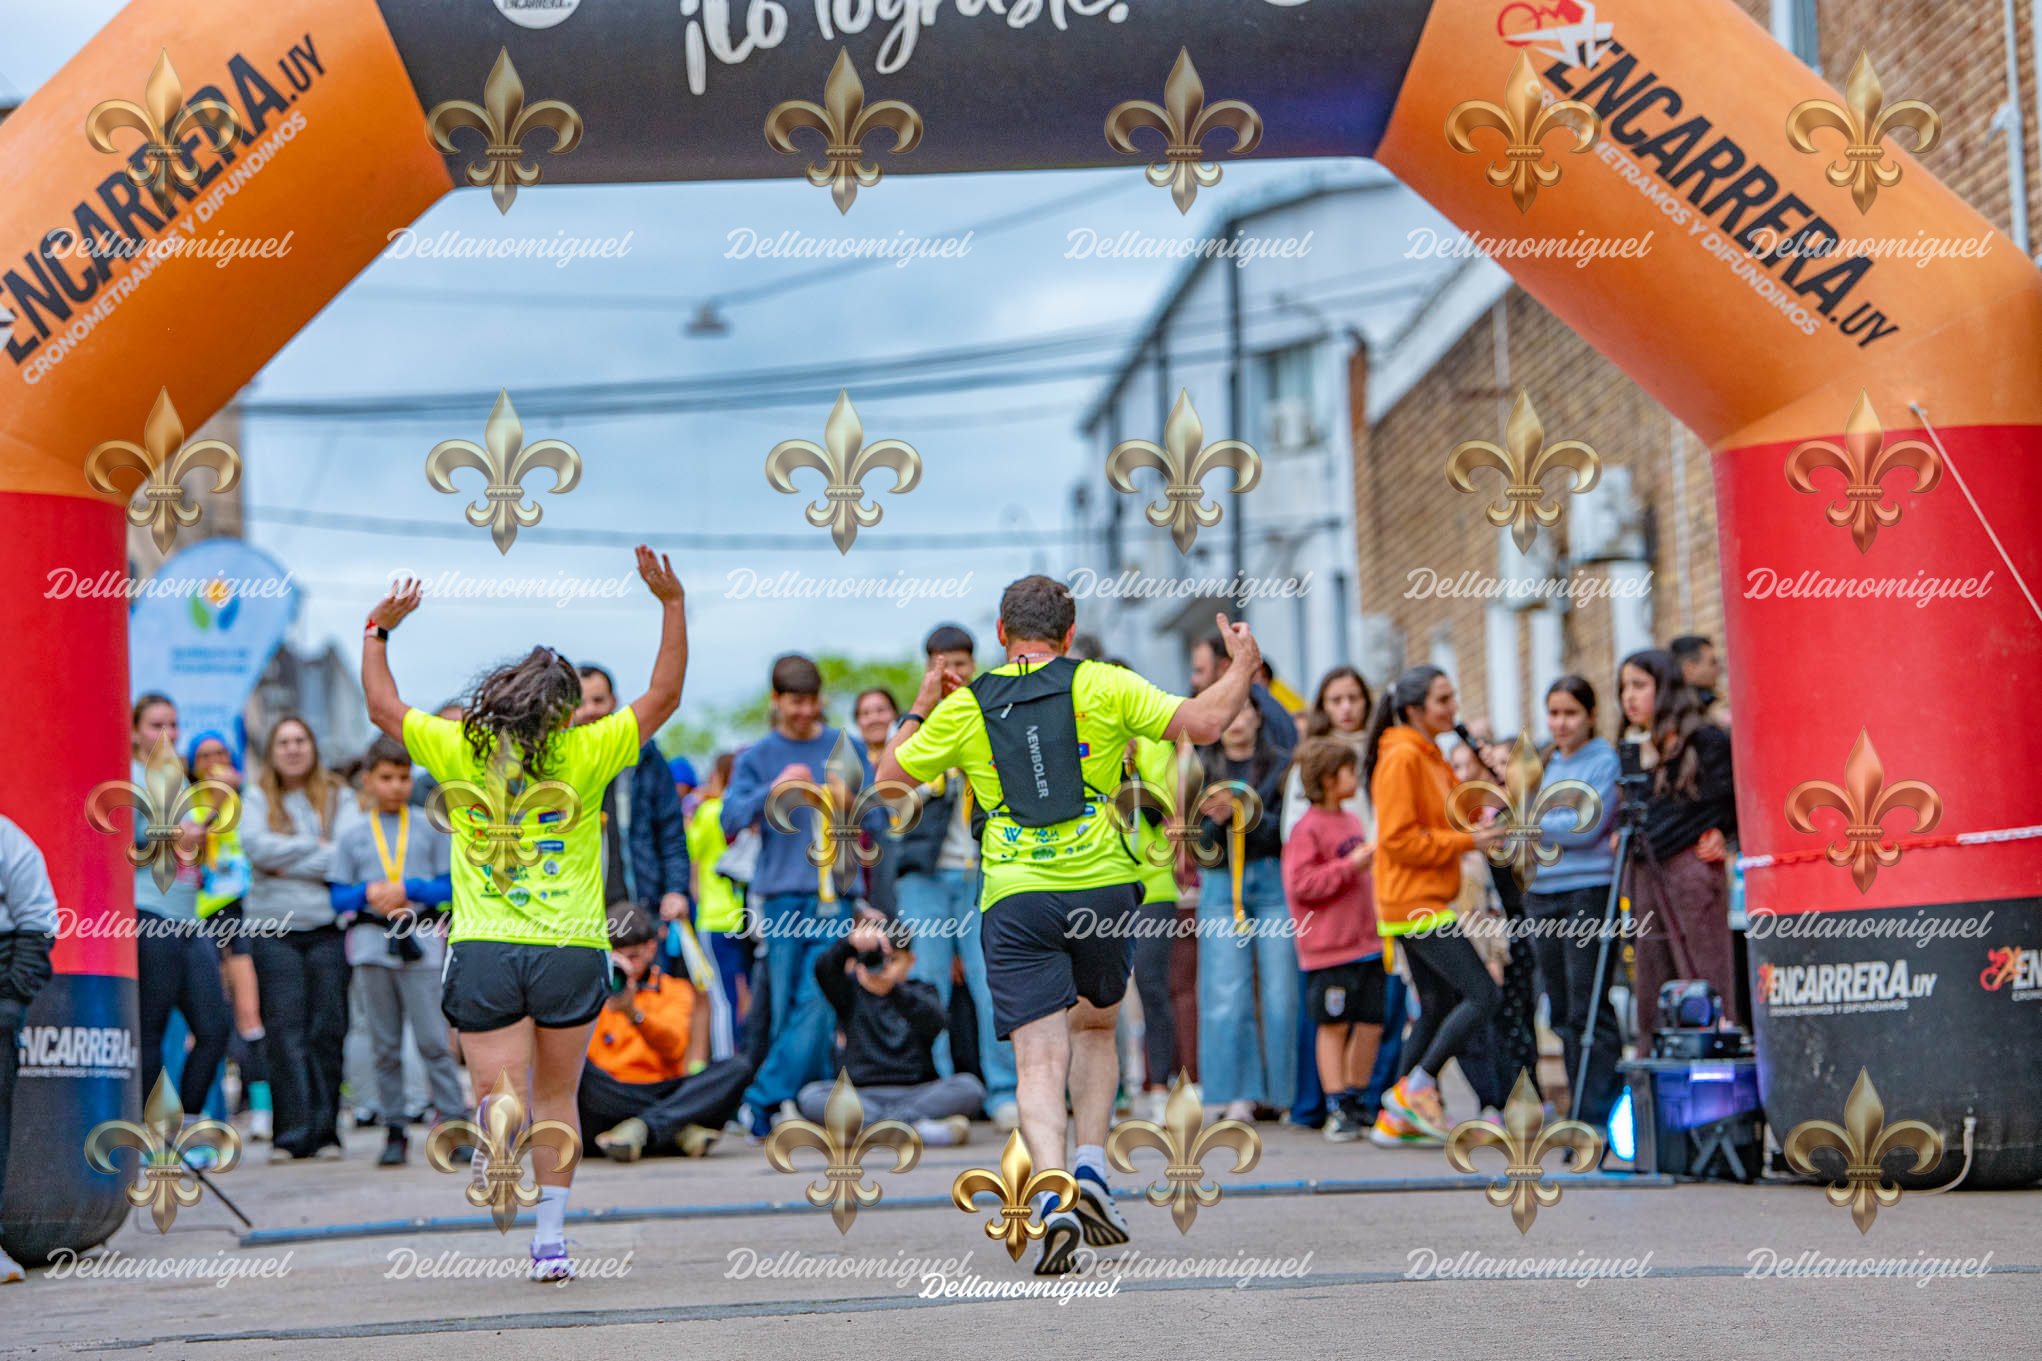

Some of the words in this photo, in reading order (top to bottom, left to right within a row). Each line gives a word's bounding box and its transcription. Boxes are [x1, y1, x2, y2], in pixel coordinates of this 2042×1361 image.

[195, 110, 308, 223] DIFUNDIMOS
[1701, 229, 1821, 336] DIFUNDIMOS
[1025, 725, 1049, 799] NEWBOLER
[1769, 959, 1937, 1006] ENCARRERA.UY
